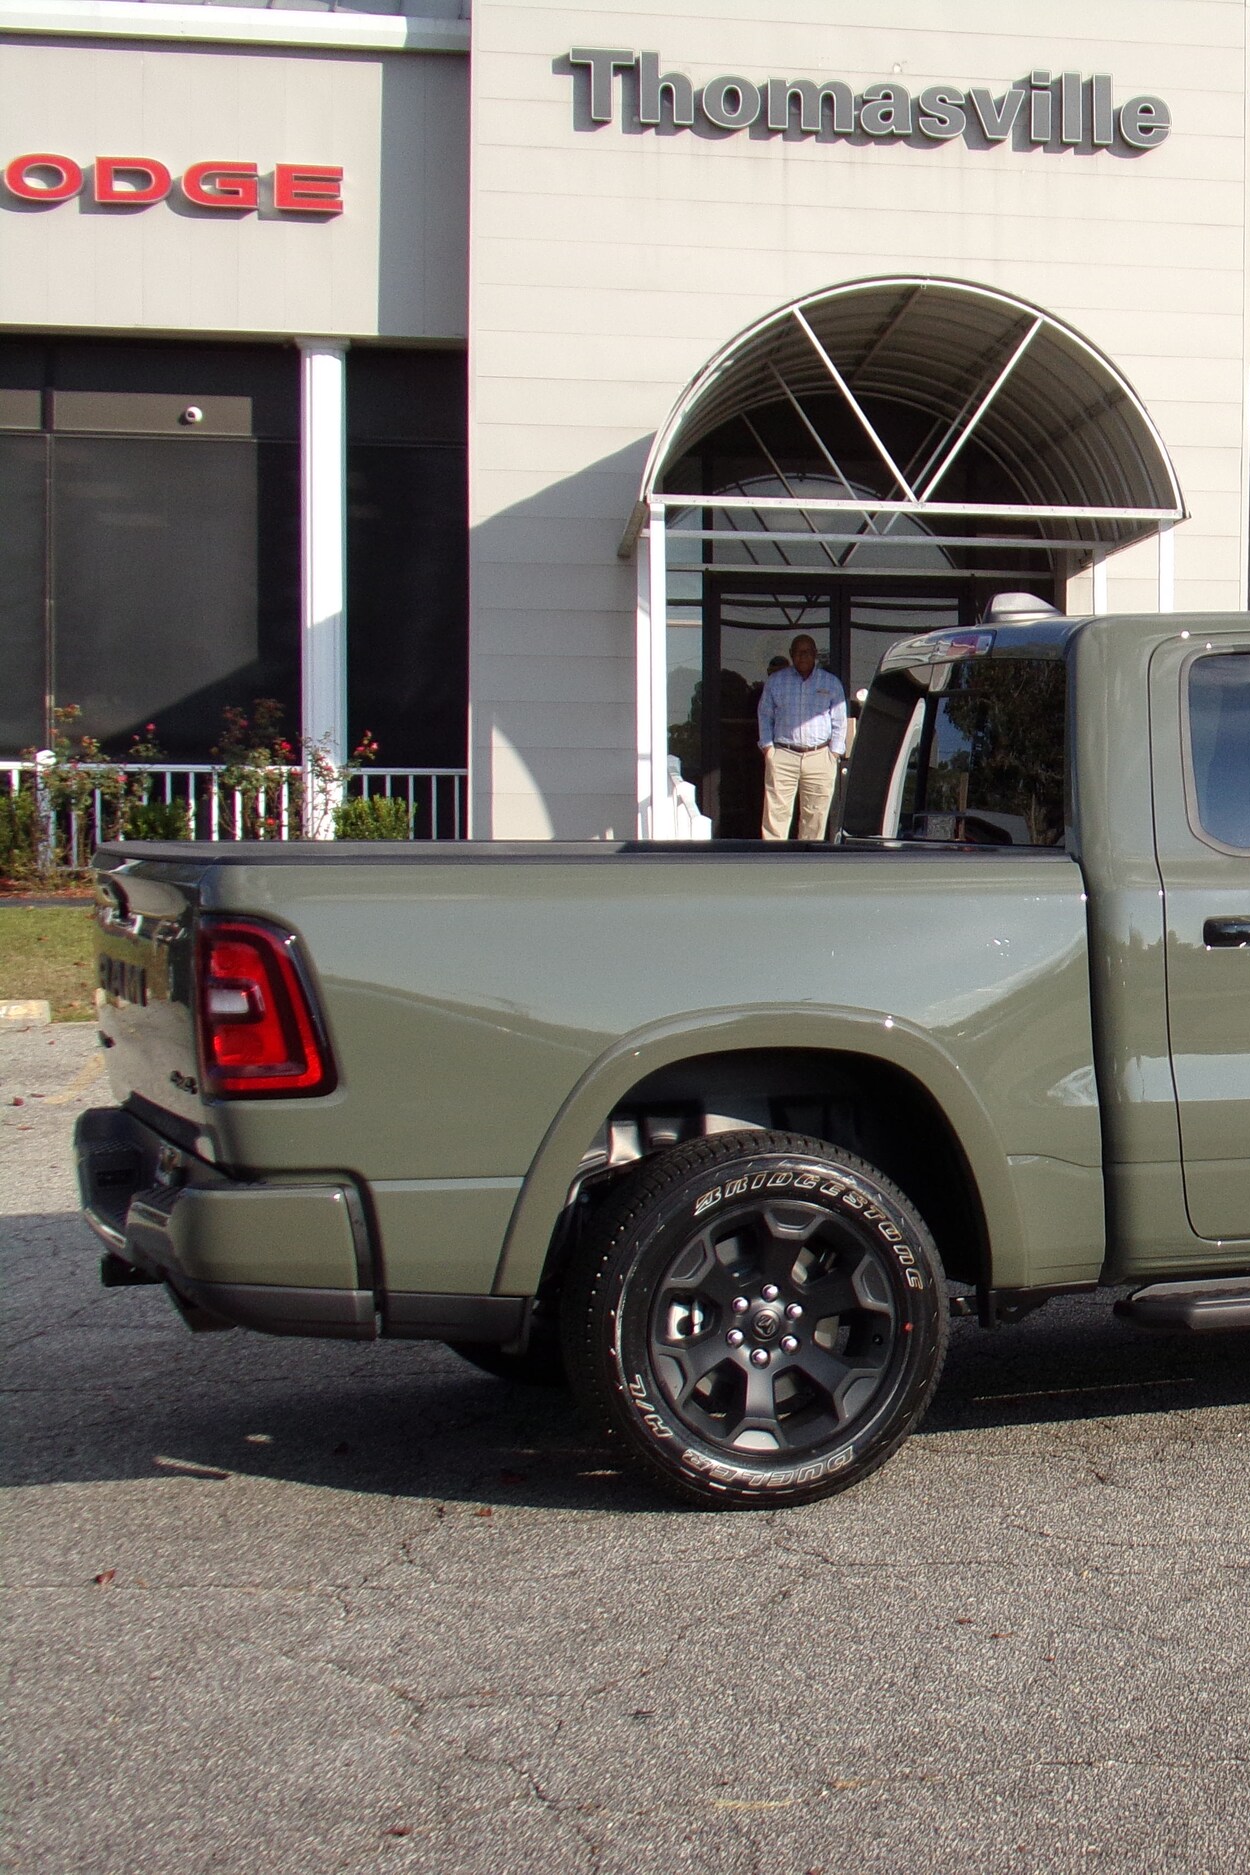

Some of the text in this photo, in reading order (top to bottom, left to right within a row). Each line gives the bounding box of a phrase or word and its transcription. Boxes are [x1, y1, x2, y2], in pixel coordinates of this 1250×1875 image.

[569, 46, 1173, 149] Thomasville
[3, 152, 345, 215] ODGE
[693, 1171, 924, 1291] BRIDGESTONE
[682, 1445, 854, 1487] DUELER
